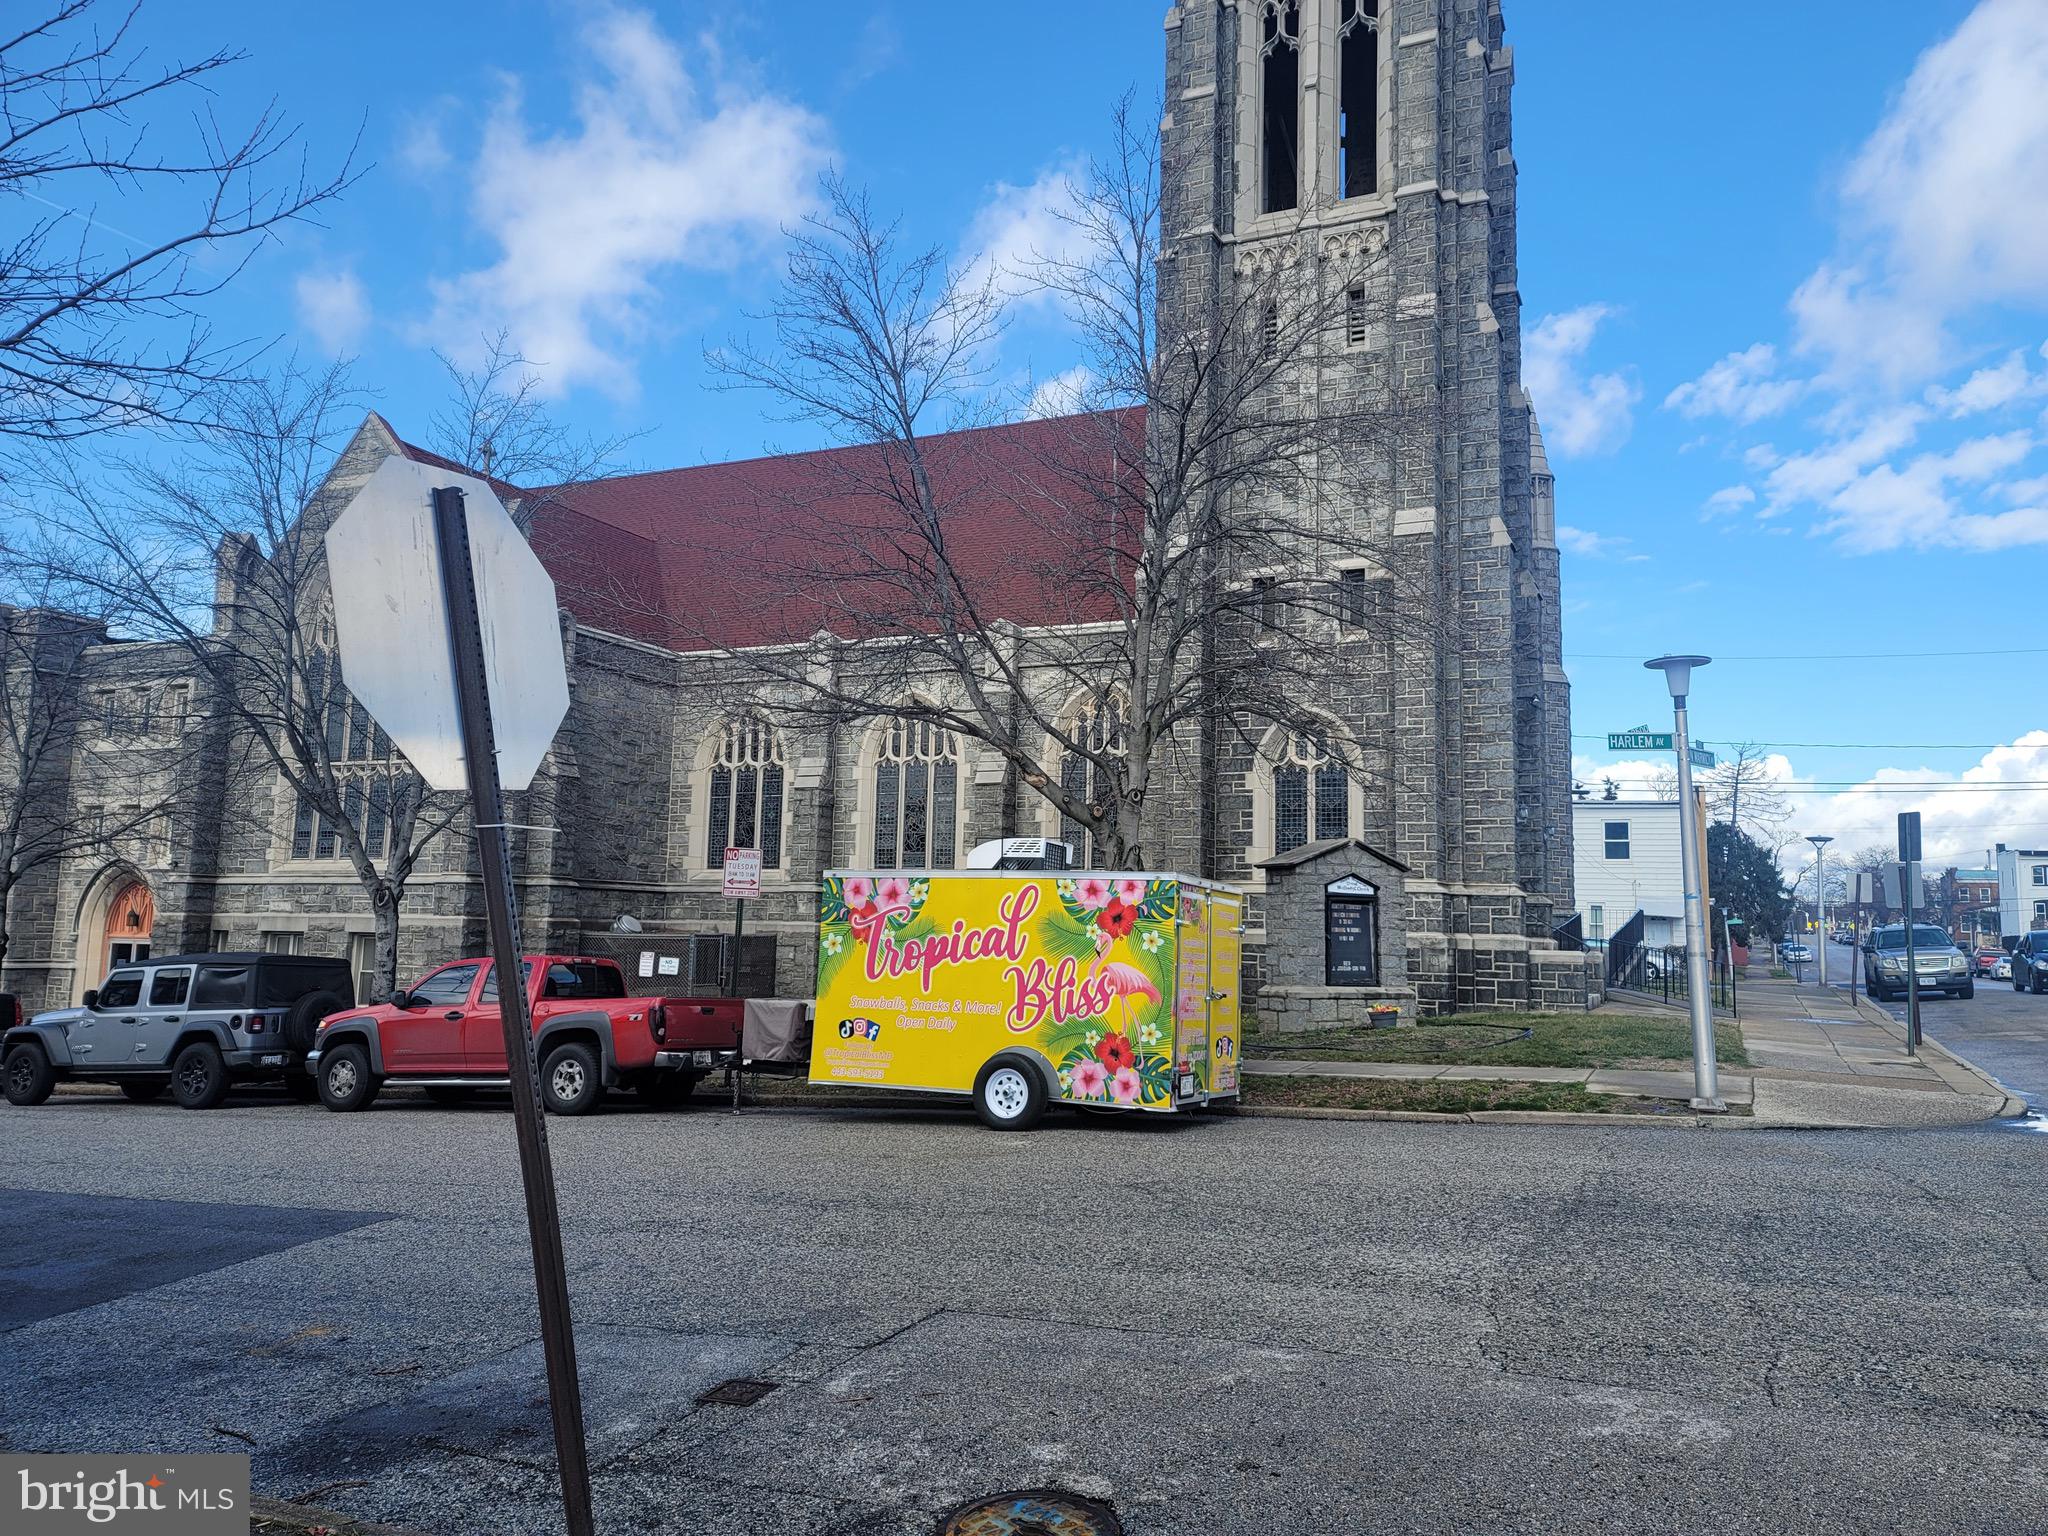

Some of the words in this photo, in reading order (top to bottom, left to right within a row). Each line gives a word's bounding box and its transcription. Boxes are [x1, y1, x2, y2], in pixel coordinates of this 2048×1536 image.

[1609, 735, 1654, 748] HARLEM
[726, 850, 739, 860] NO
[740, 851, 760, 860] PARKING
[728, 863, 758, 871] TUESDAY
[853, 884, 1040, 993] Tropical
[1004, 957, 1116, 1032] Bliss
[850, 996, 908, 1012] Snowballs,
[911, 998, 949, 1012] Snacks
[952, 999, 963, 1013] &
[965, 1001, 1003, 1015] More!
[895, 1014, 925, 1029] Open
[927, 1016, 958, 1032] Daily
